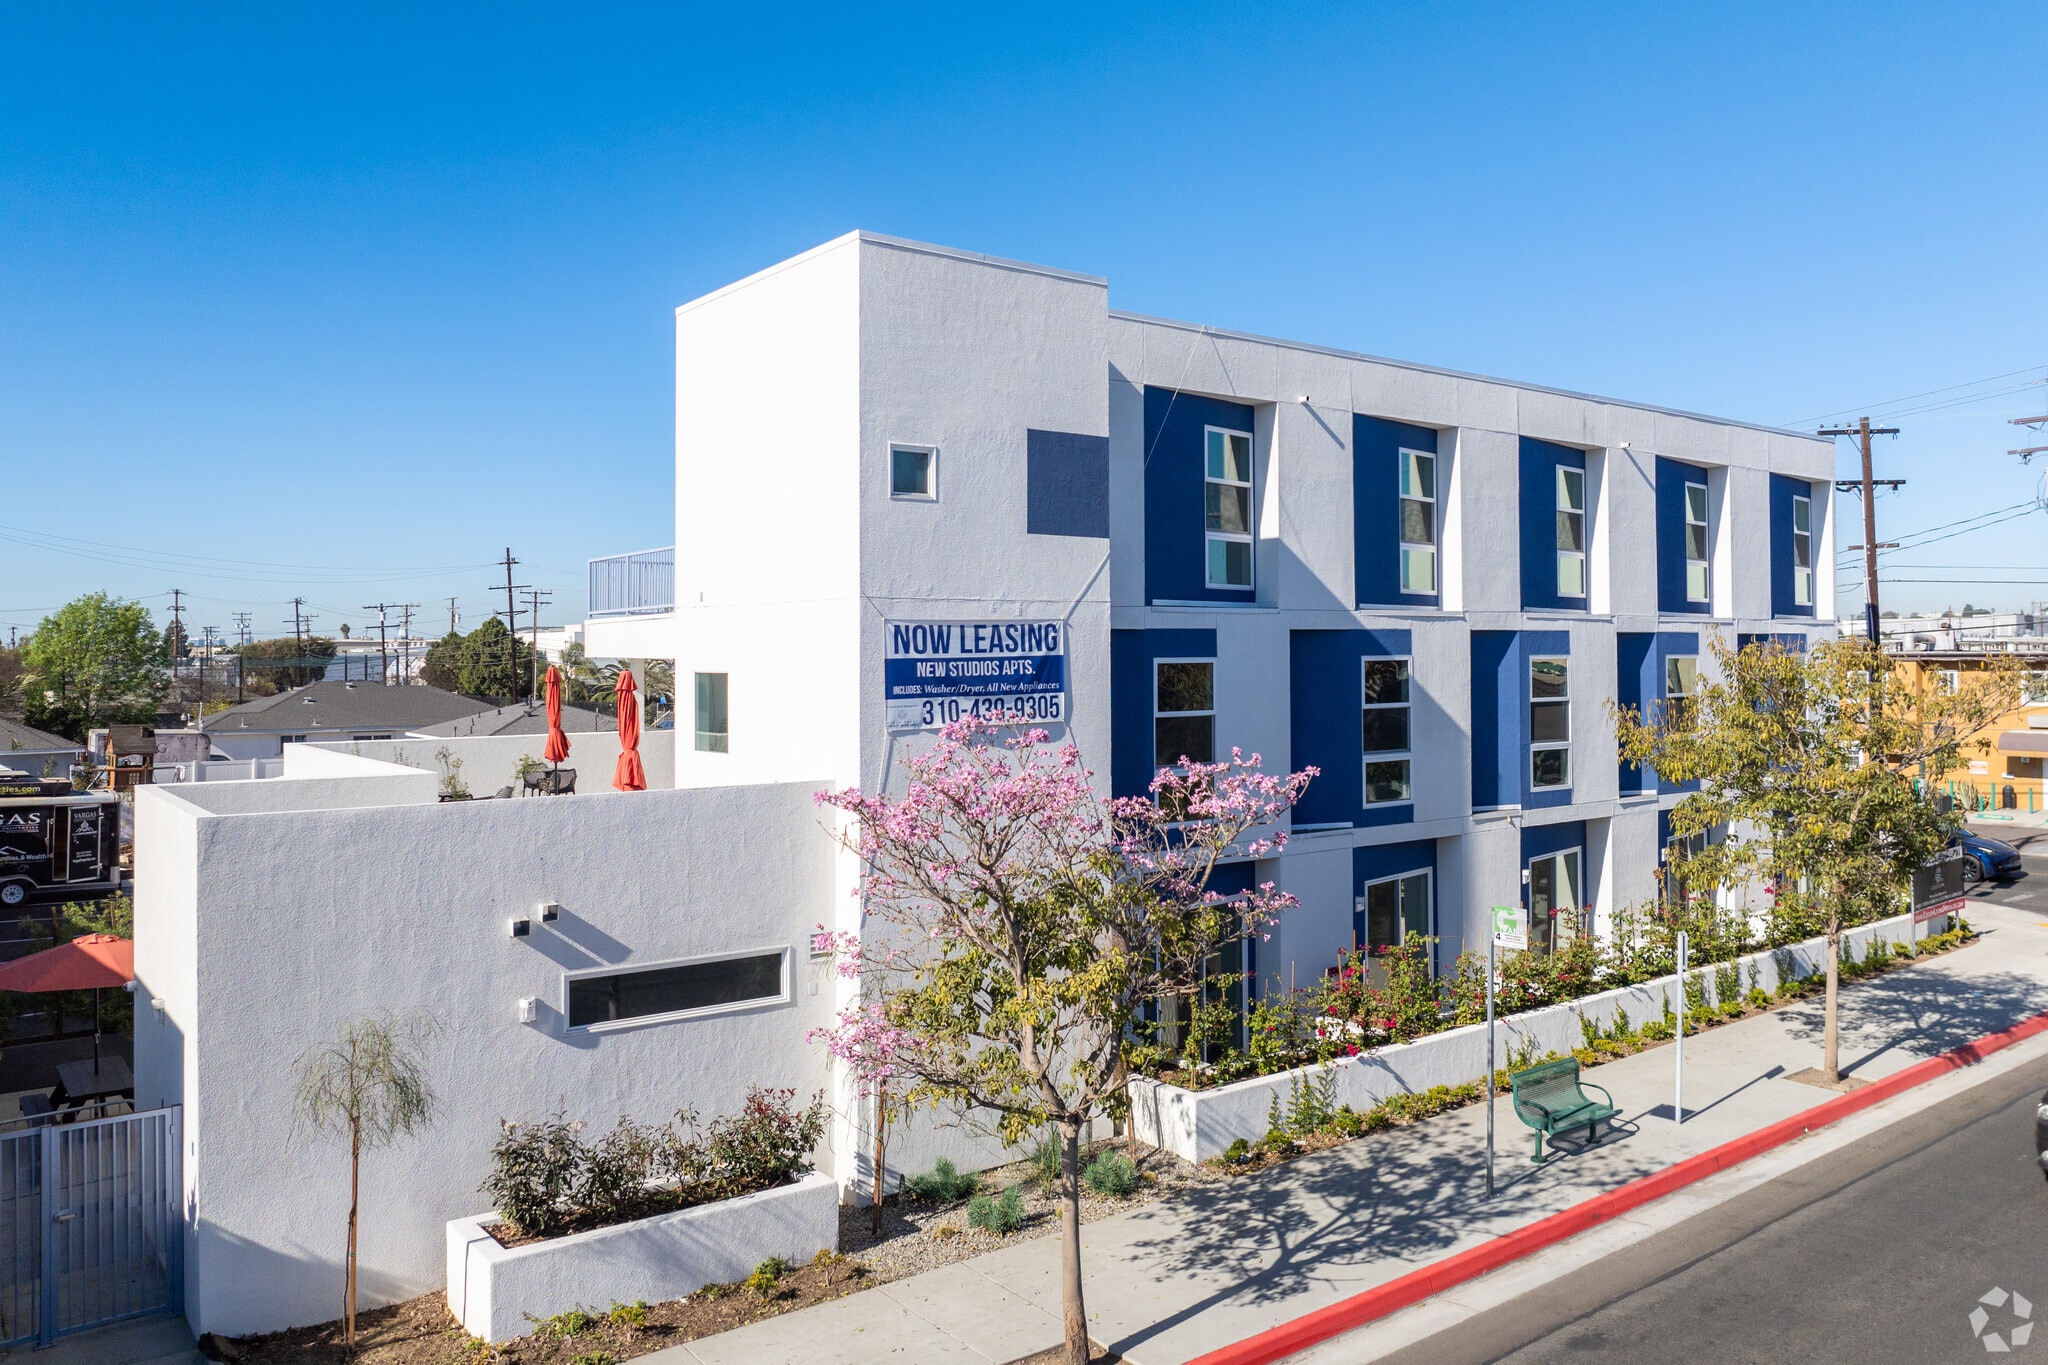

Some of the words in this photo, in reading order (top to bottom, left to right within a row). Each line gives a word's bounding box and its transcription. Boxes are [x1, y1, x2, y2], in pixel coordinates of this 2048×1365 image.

[893, 624, 952, 655] NOW
[960, 623, 1058, 654] LEASING
[916, 662, 946, 678] NEW
[949, 660, 1000, 677] STUDIOS
[1002, 659, 1036, 675] APTS.
[892, 685, 923, 695] INCLUDES:
[924, 684, 985, 695] Washer/Dryer,
[986, 683, 999, 693] All
[1000, 683, 1017, 692] New
[1018, 681, 1060, 693] Appliances
[922, 695, 1060, 726] 310-439-9305
